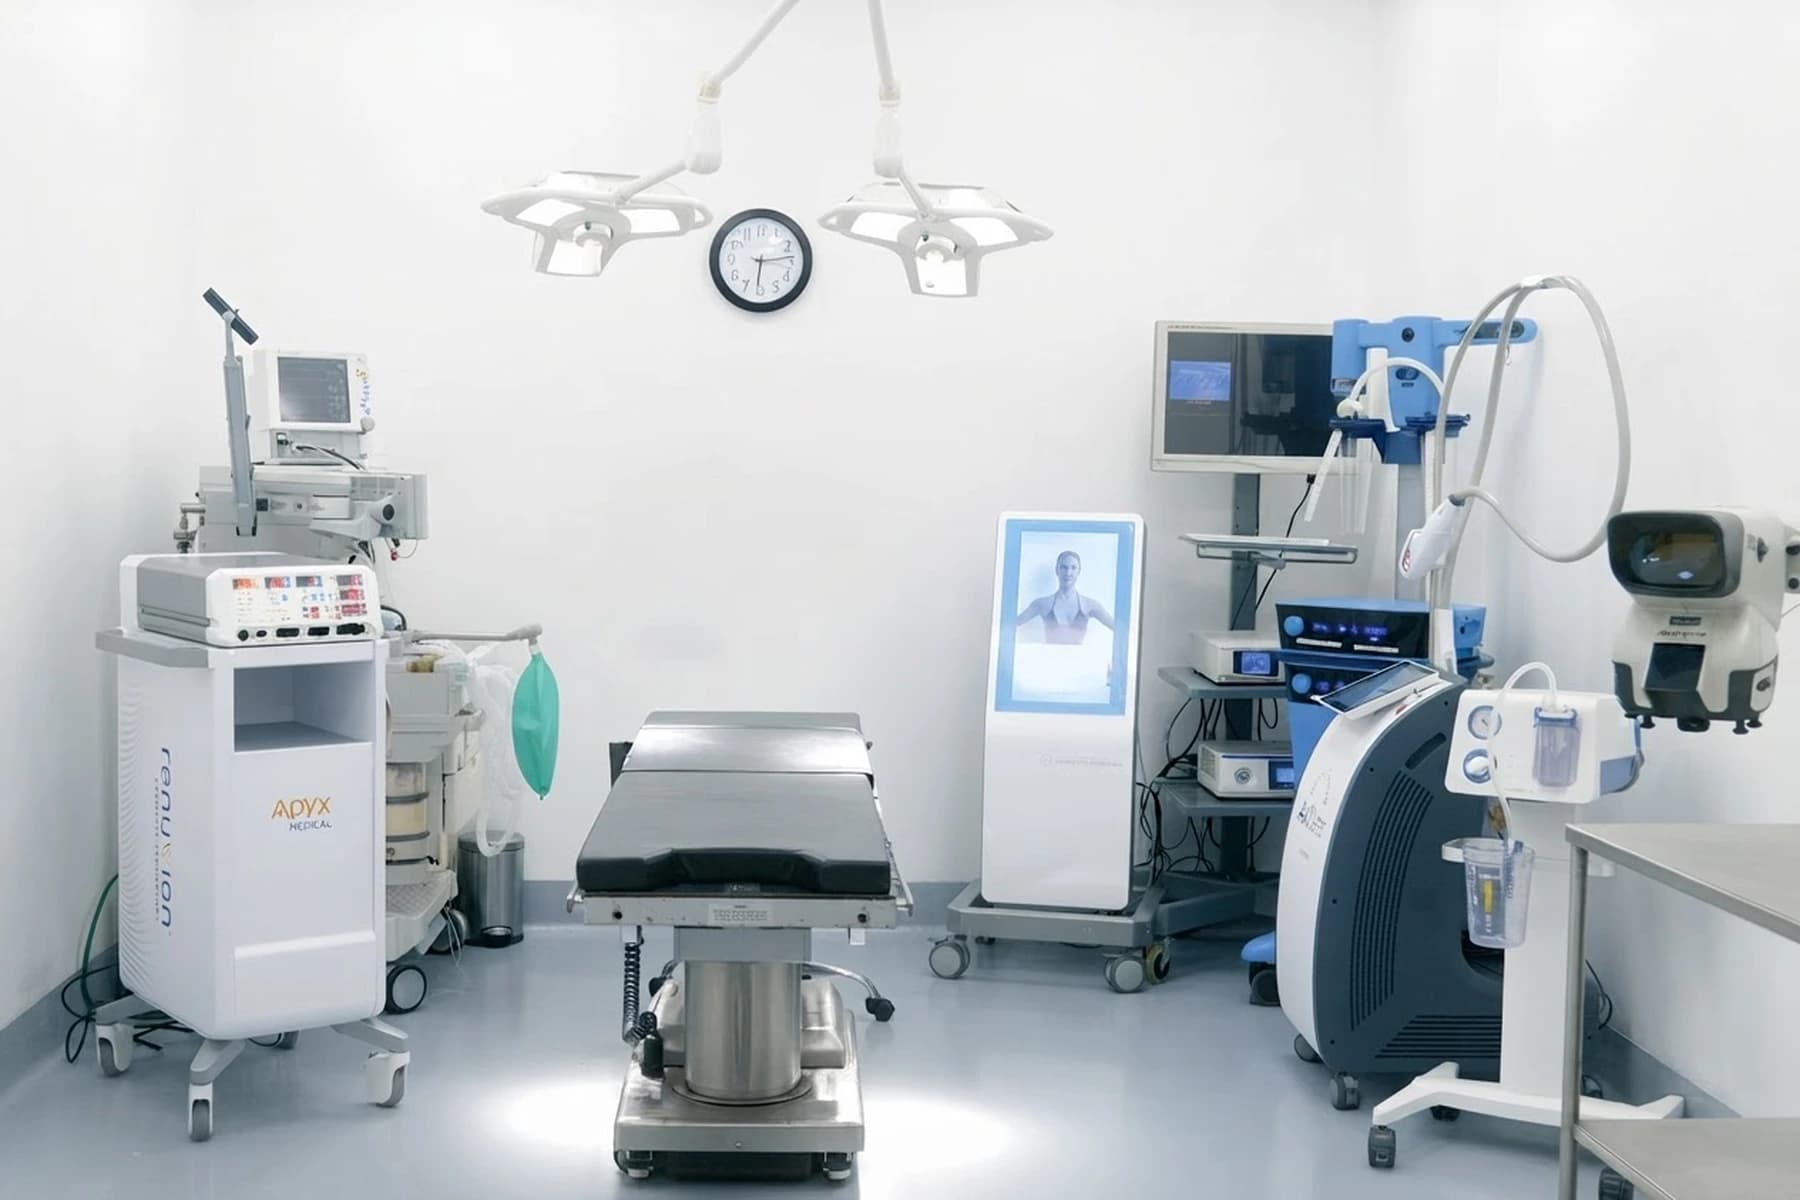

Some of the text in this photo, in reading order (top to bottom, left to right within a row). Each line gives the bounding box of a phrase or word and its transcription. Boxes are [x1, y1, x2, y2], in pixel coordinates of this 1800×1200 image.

[783, 240, 792, 253] 2
[742, 279, 750, 293] 7
[771, 280, 780, 294] 5
[289, 820, 332, 832] MEDICAL
